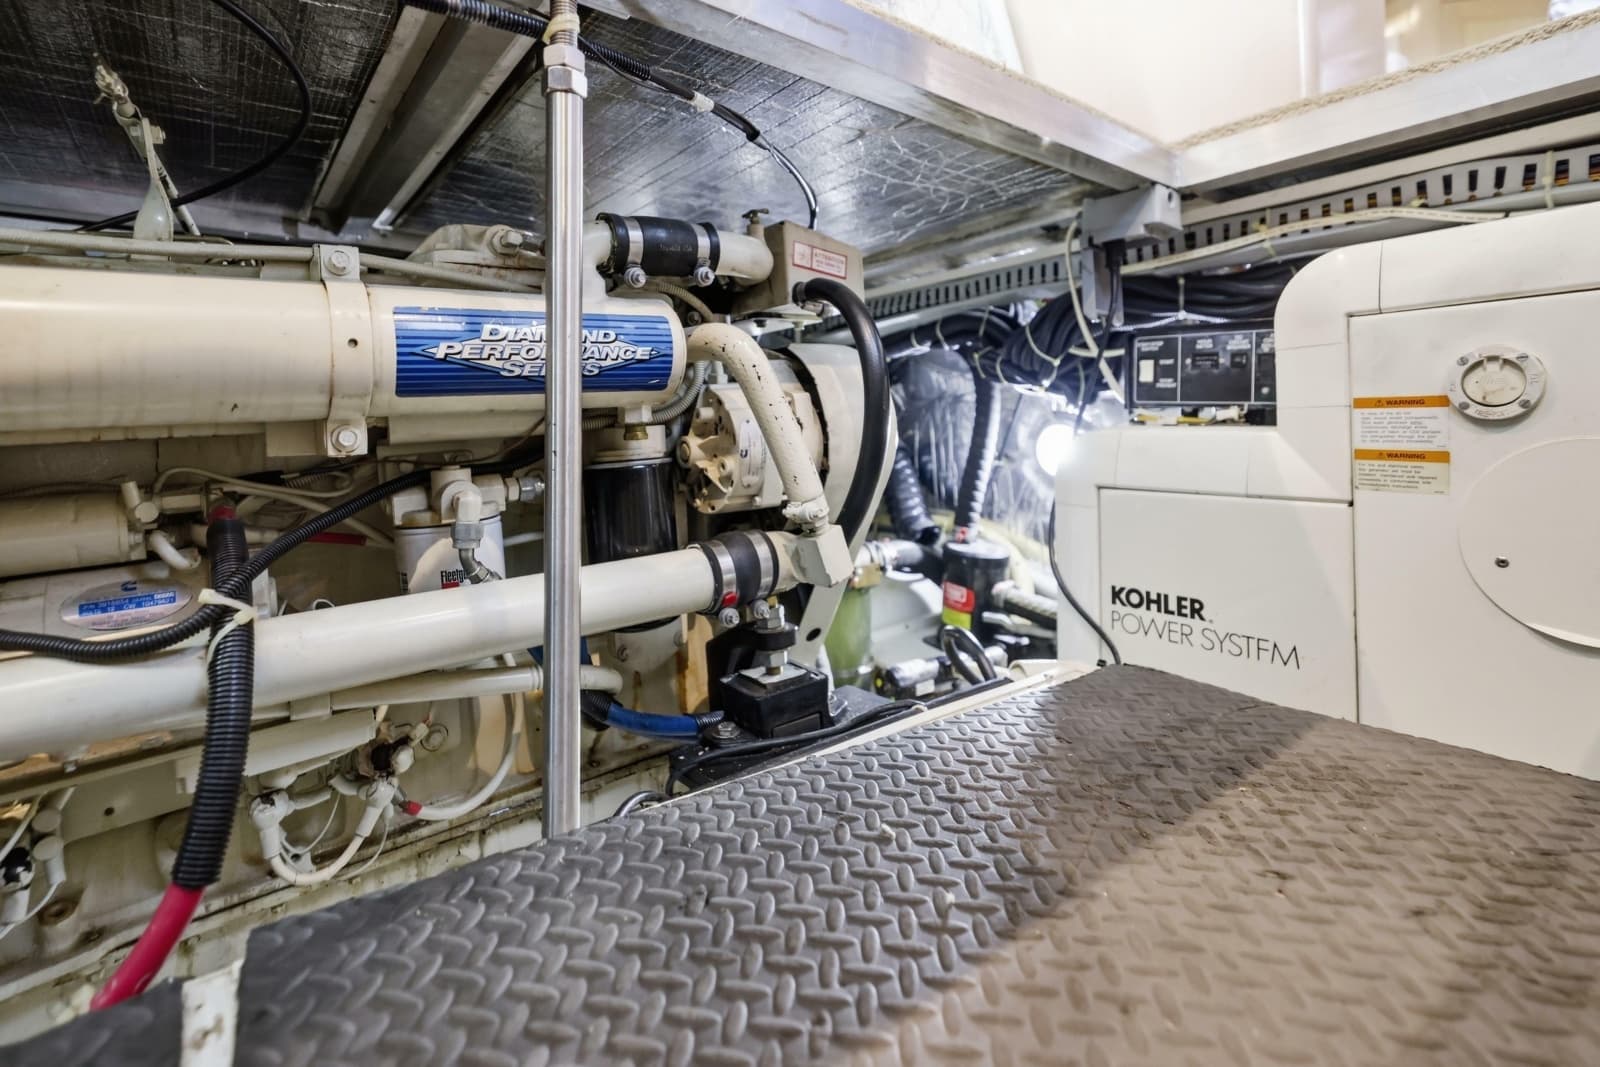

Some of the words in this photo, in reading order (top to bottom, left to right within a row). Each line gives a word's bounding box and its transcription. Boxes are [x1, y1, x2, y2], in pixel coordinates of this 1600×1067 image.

[481, 324, 616, 343] DIAND
[435, 341, 652, 360] PERFOANCE
[500, 360, 600, 377] SES
[1386, 398, 1425, 406] WARNING
[1386, 451, 1426, 460] WARNING
[1111, 585, 1206, 622] KOHLER
[1111, 611, 1194, 647] POWER
